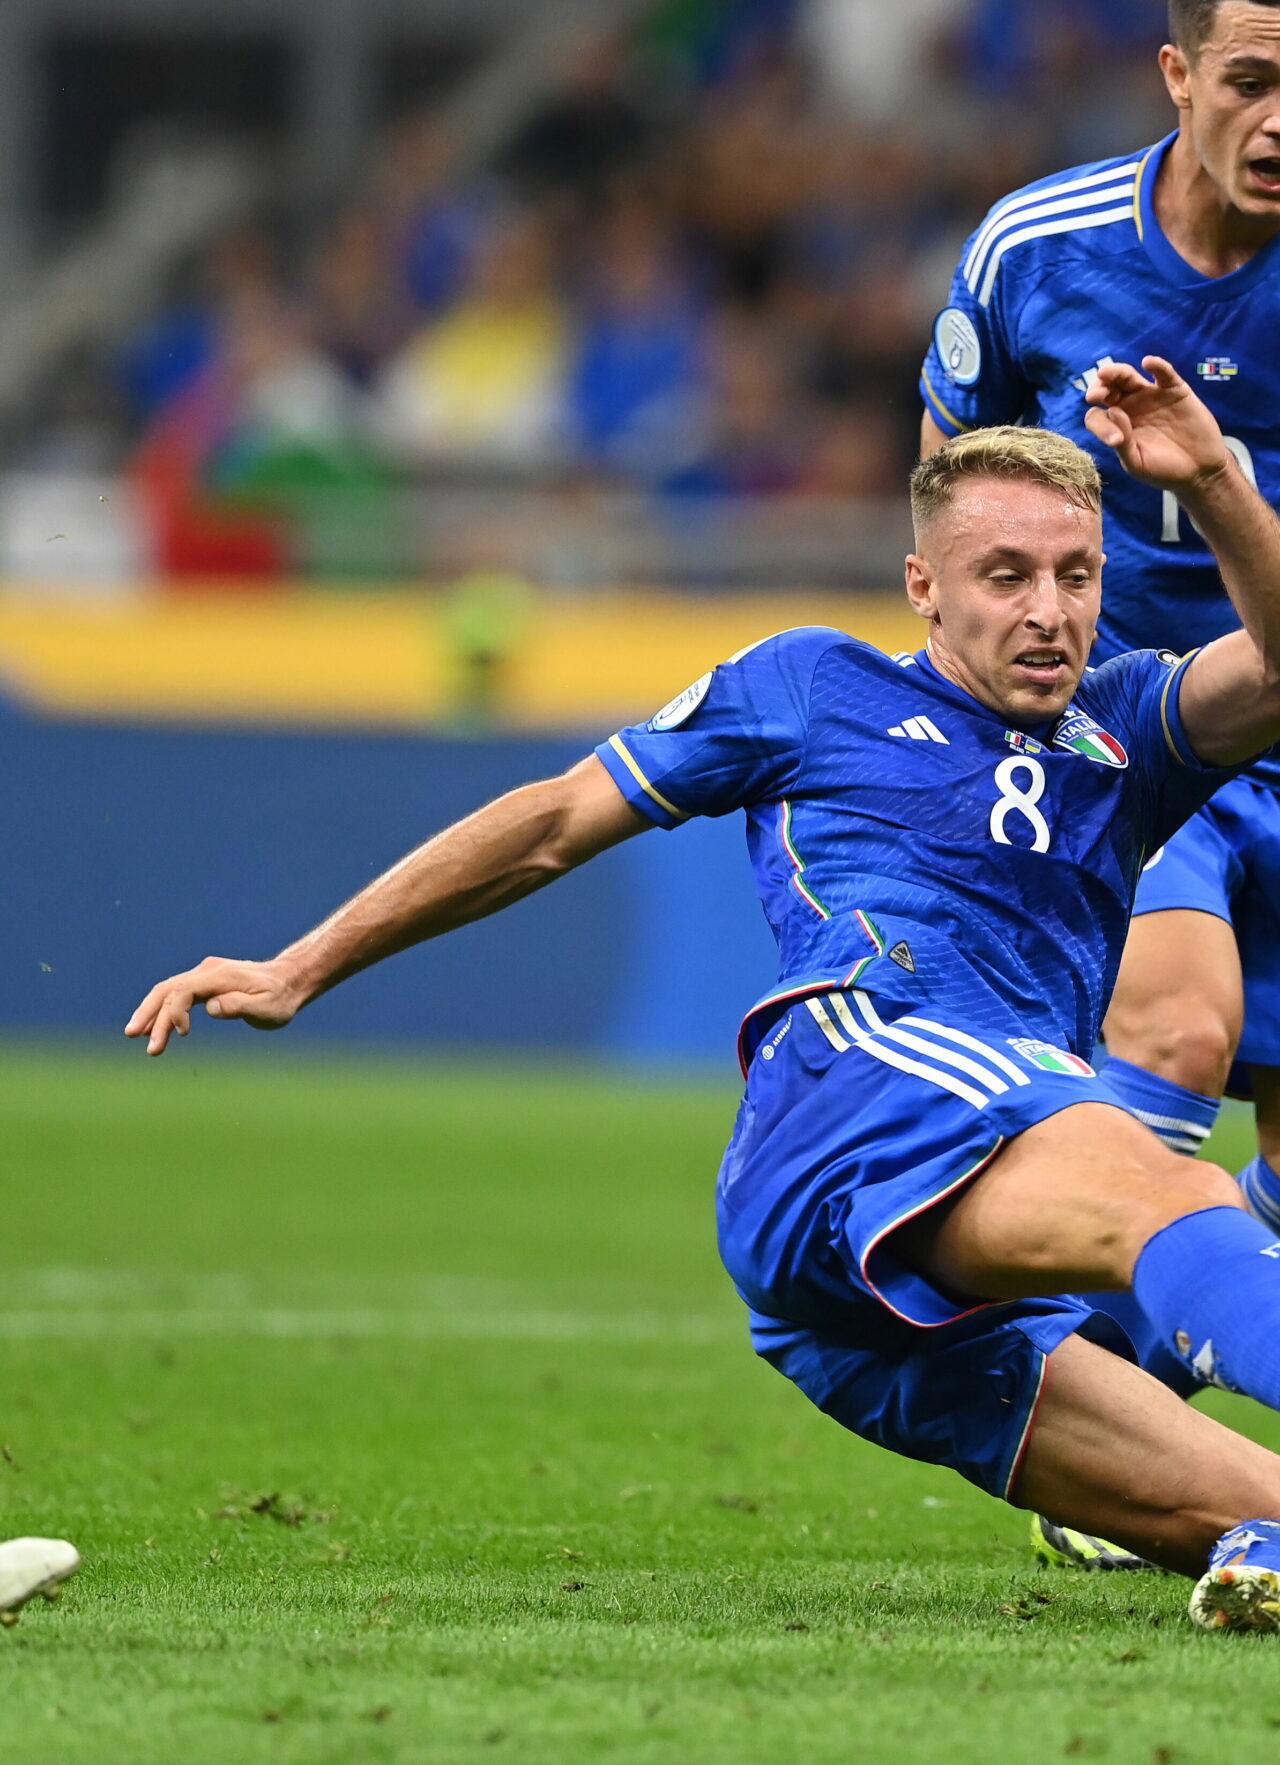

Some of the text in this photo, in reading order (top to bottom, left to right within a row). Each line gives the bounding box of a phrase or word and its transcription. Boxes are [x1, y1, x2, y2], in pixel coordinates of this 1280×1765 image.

[1161, 435, 1259, 541] 1
[1056, 719, 1099, 741] ITALIA
[990, 755, 1050, 853] 8
